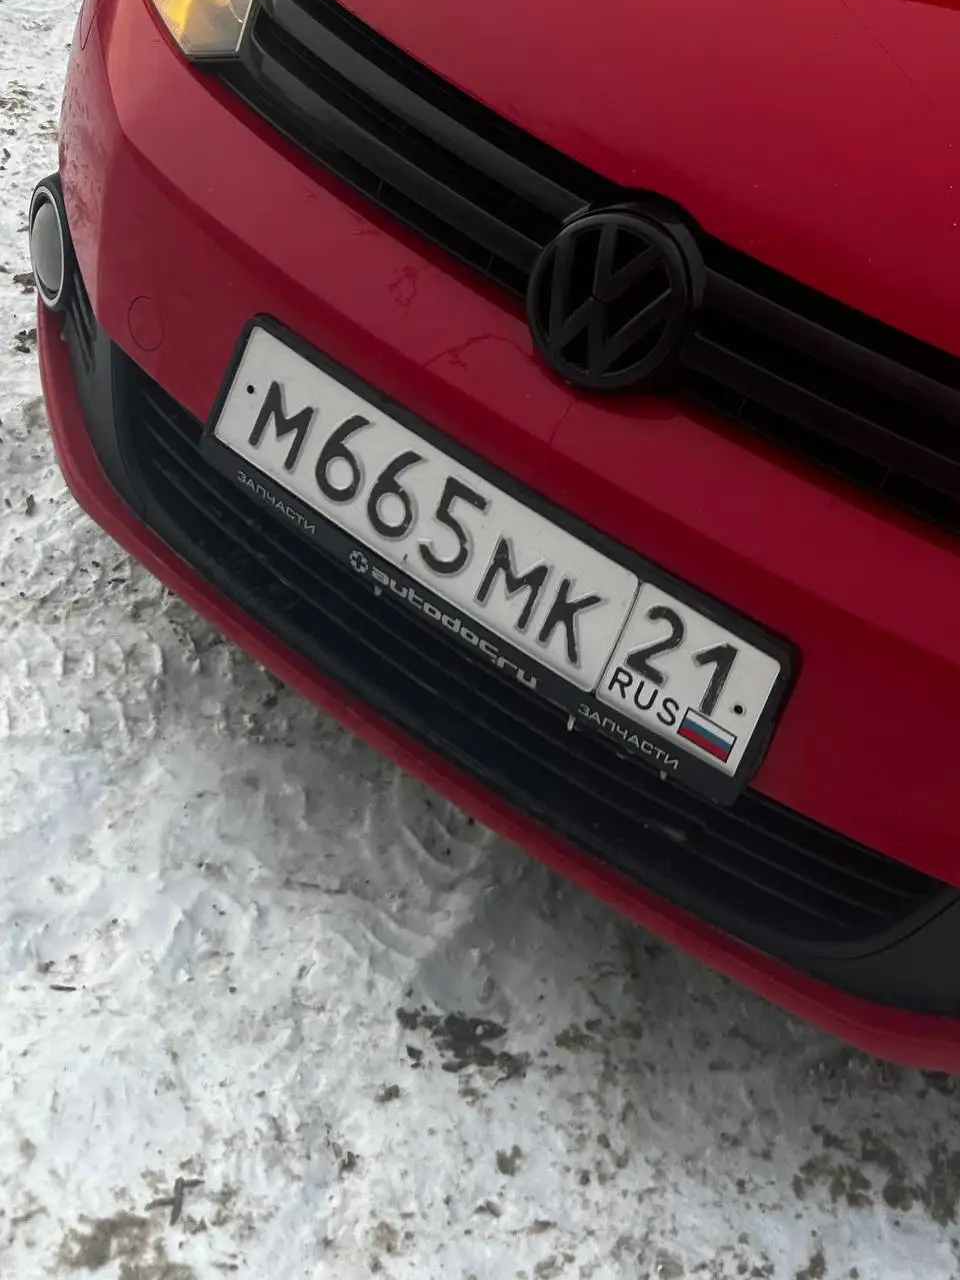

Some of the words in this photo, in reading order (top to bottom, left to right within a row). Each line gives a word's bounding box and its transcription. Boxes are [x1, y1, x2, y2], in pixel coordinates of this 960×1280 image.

[236, 470, 316, 536] ЗАПЧАСТИ
[371, 566, 537, 690] autodoc.ru
[625, 605, 738, 717] 21
[607, 667, 680, 727] RUS
[577, 703, 680, 771] ЗАПЧАСТИ
